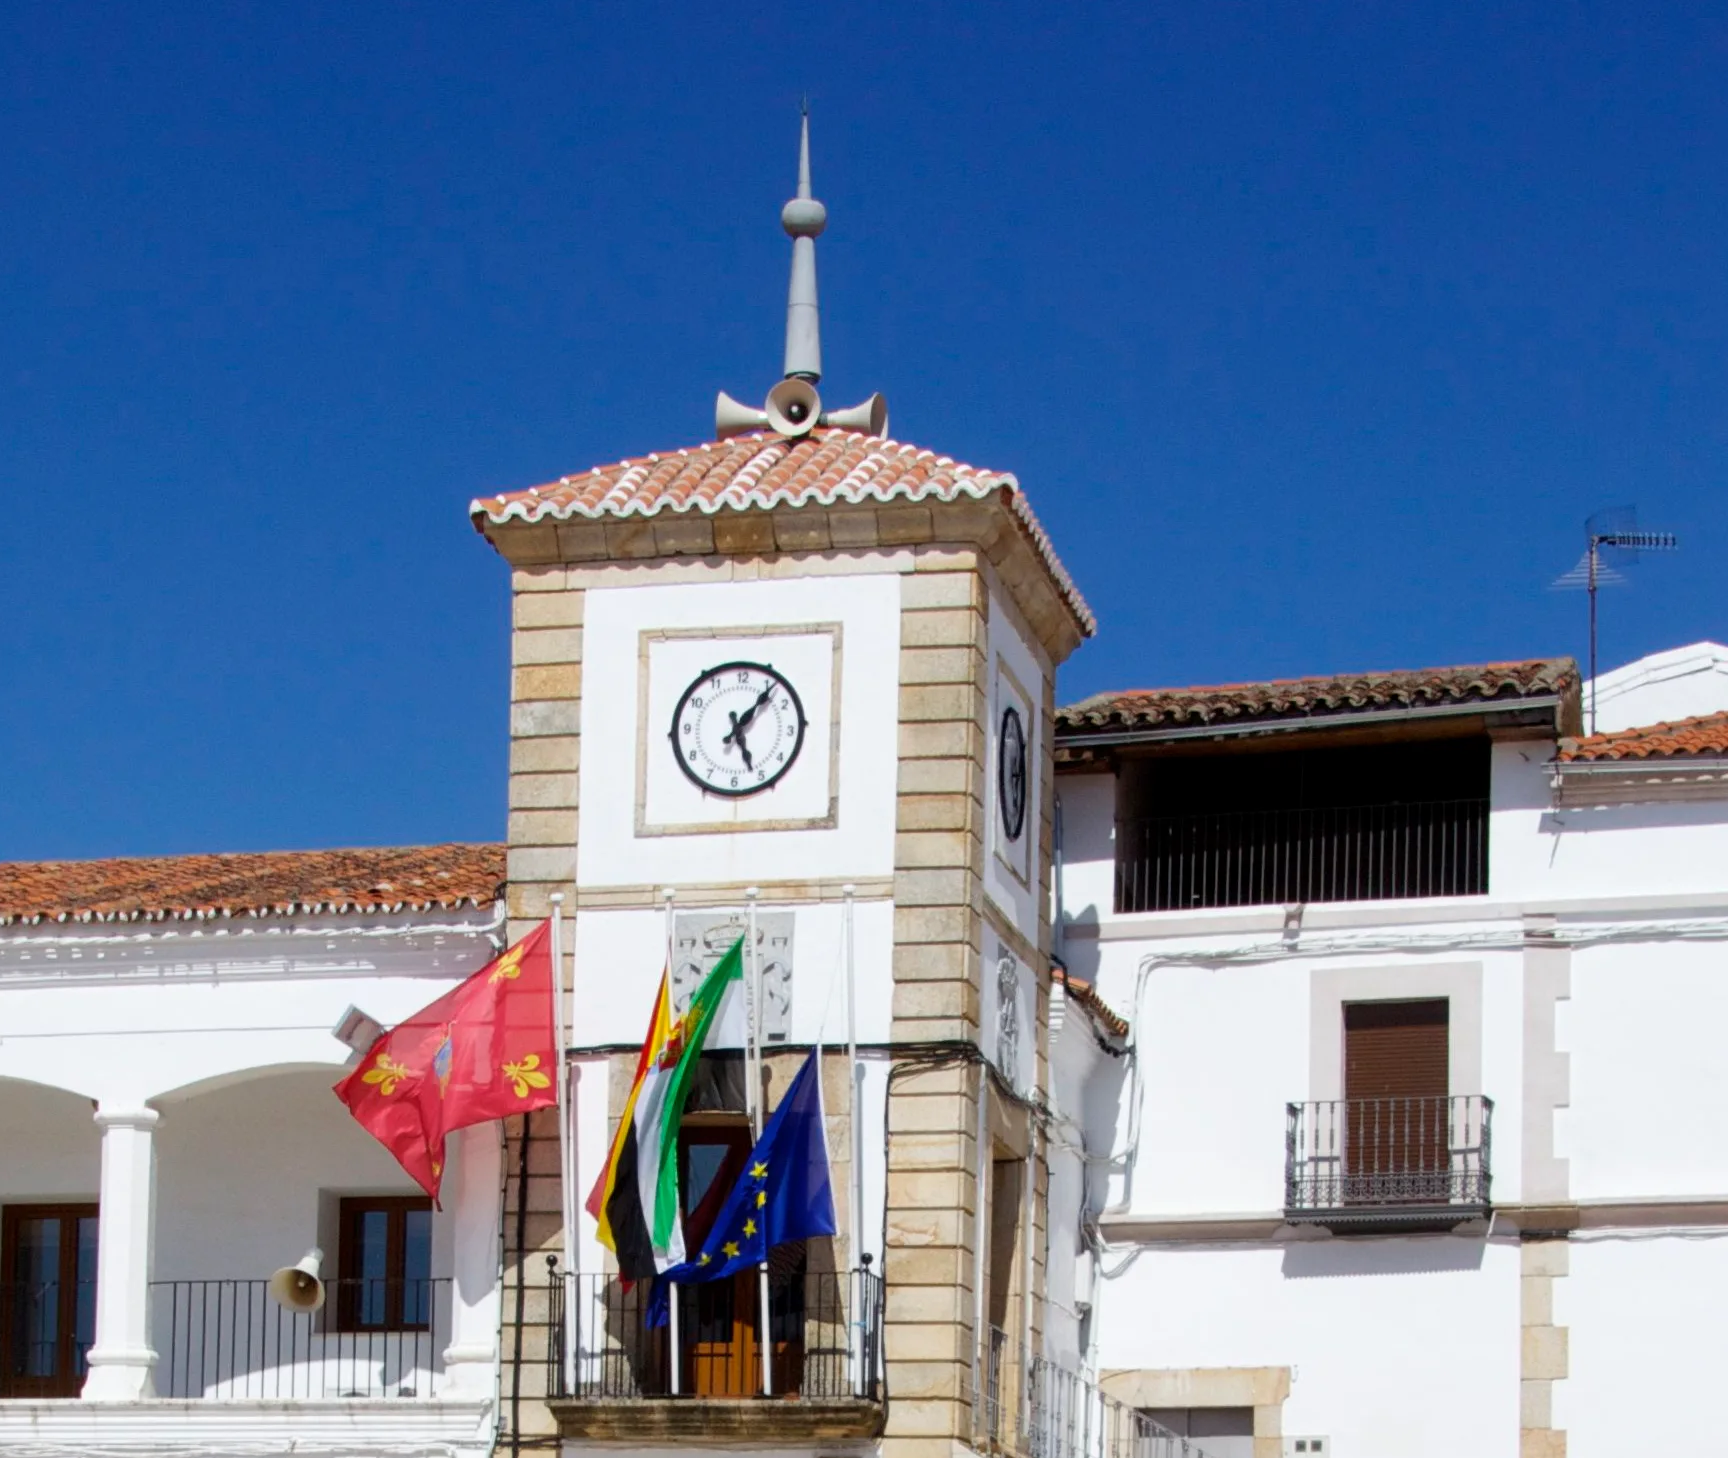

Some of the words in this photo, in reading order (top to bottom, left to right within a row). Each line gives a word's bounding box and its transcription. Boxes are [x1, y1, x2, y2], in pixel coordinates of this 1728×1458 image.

[711, 678, 721, 689] 11
[737, 672, 749, 684] 12
[691, 698, 703, 708] 10
[781, 699, 789, 710] 2
[684, 724, 691, 734] 9
[787, 726, 794, 737] 3
[689, 750, 697, 761] 8
[776, 752, 784, 763] 4
[706, 768, 714, 779] 7
[758, 770, 765, 781] 5
[731, 776, 738, 787] 6
